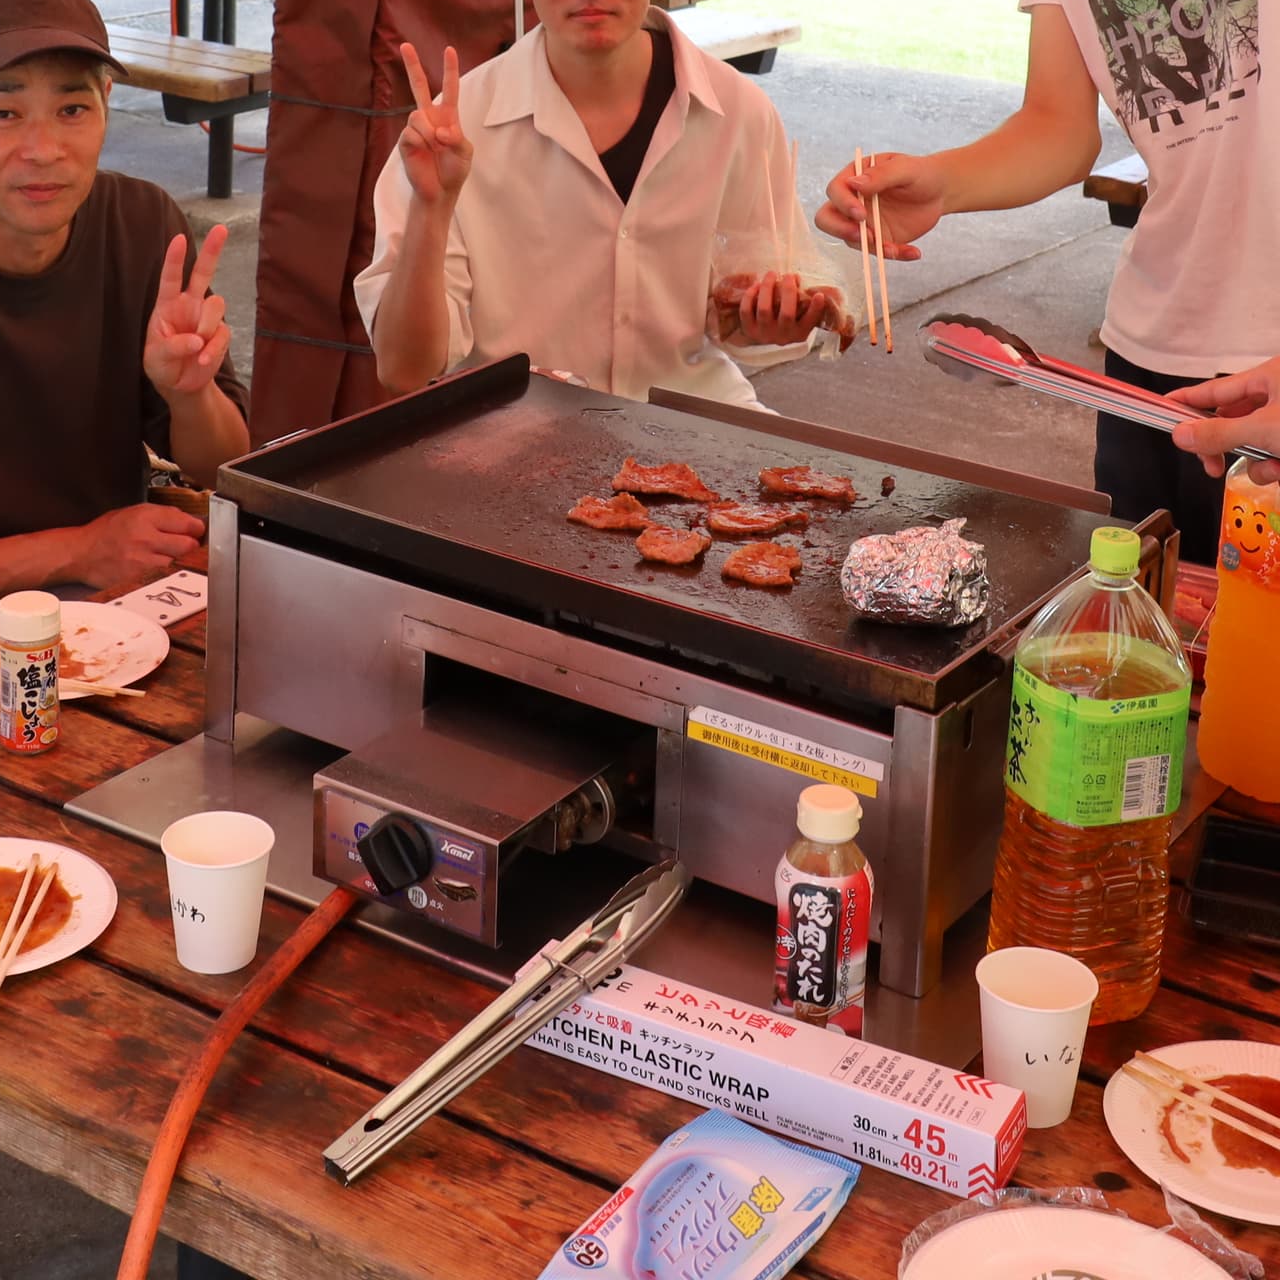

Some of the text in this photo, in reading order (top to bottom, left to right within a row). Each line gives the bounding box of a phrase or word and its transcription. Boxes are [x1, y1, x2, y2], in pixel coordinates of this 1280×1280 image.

[26, 649, 53, 663] S&B
[16, 663, 42, 742] 塩こしょう
[1126, 698, 1158, 712] 伊藤園
[792, 891, 834, 1002] 焼肉のたれ
[643, 1000, 756, 1043] キッチンラップ
[639, 1028, 715, 1061] キッチンラップ
[532, 1031, 770, 1122] THAT IS EASY TO CUT AND STICKS WELL
[620, 1039, 703, 1081] PLASTIC
[709, 1069, 771, 1103] WRAP
[810, 1125, 844, 1143] ALIMENTOS
[693, 1170, 716, 1195] WET
[586, 1190, 627, 1234] ノンアルコール
[649, 1196, 693, 1246] TISSUES
[566, 1235, 588, 1257] 枚入
[575, 1239, 605, 1271] 50
